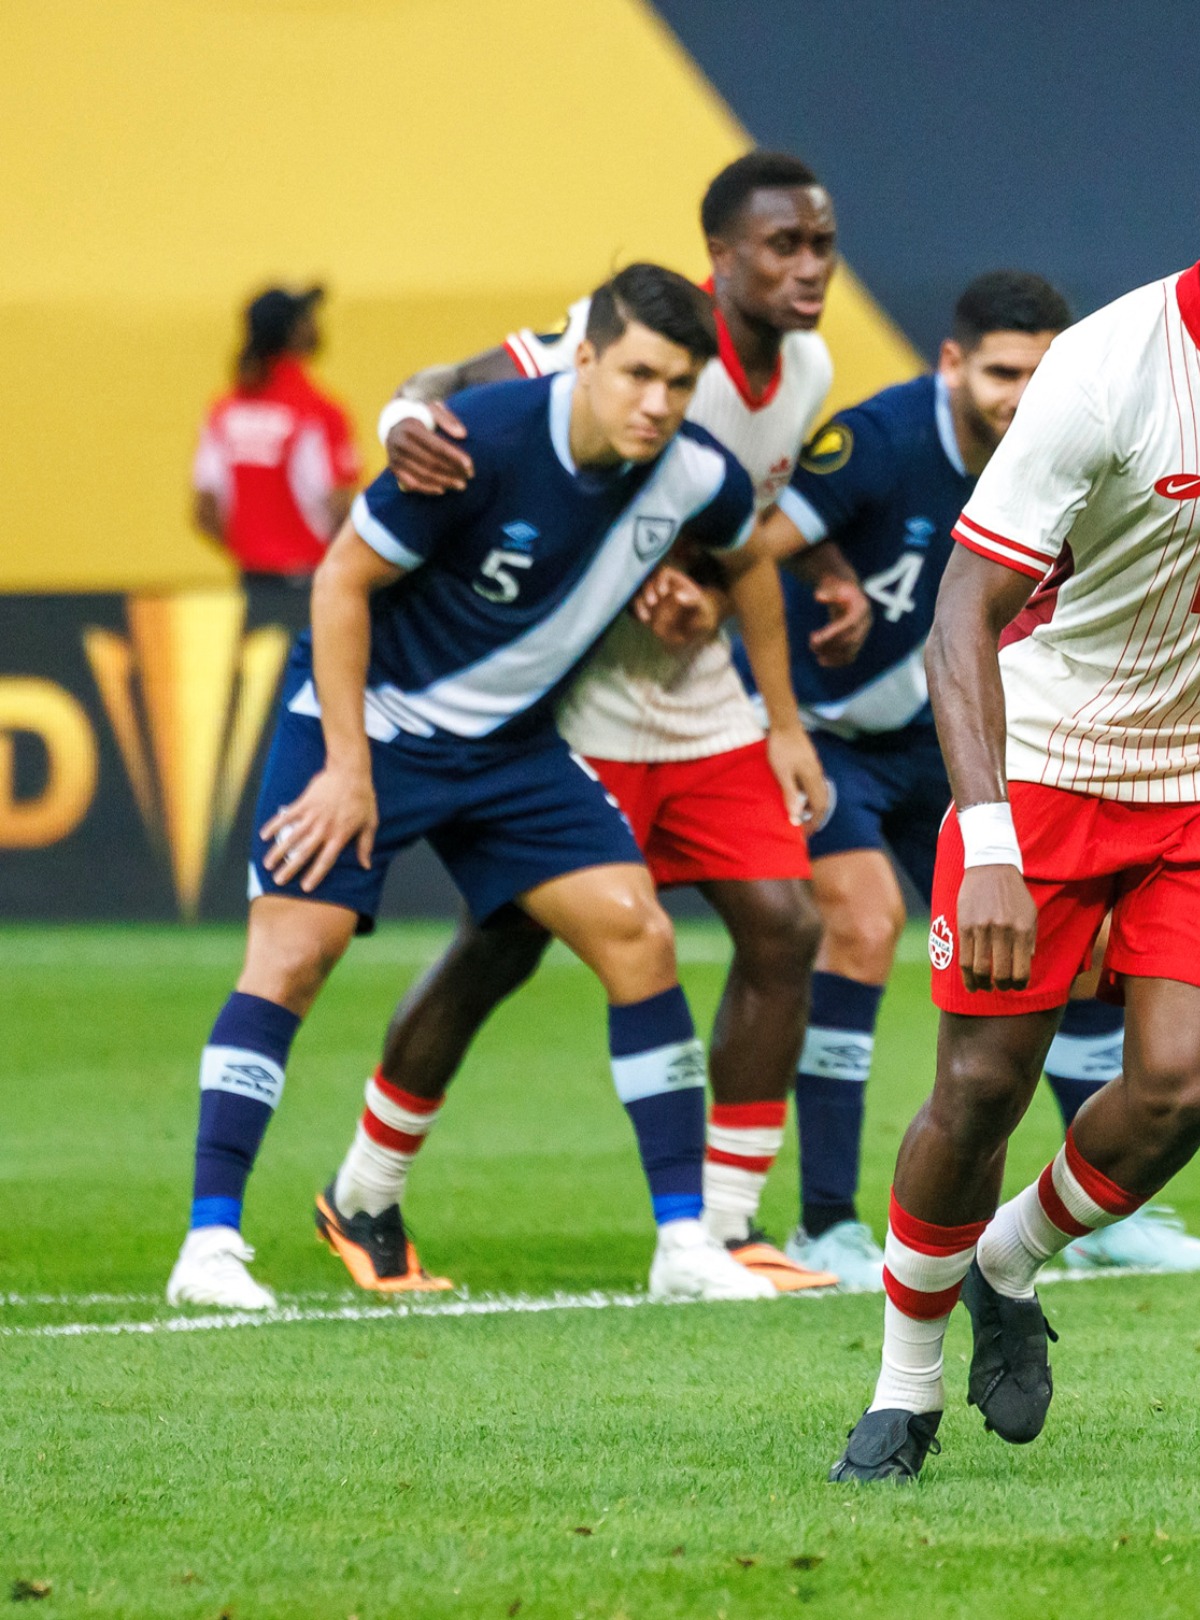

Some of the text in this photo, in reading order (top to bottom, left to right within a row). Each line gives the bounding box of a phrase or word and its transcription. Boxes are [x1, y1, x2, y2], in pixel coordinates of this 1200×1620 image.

[472, 548, 535, 604] 5
[863, 551, 926, 623] 4
[0, 673, 99, 849] D
